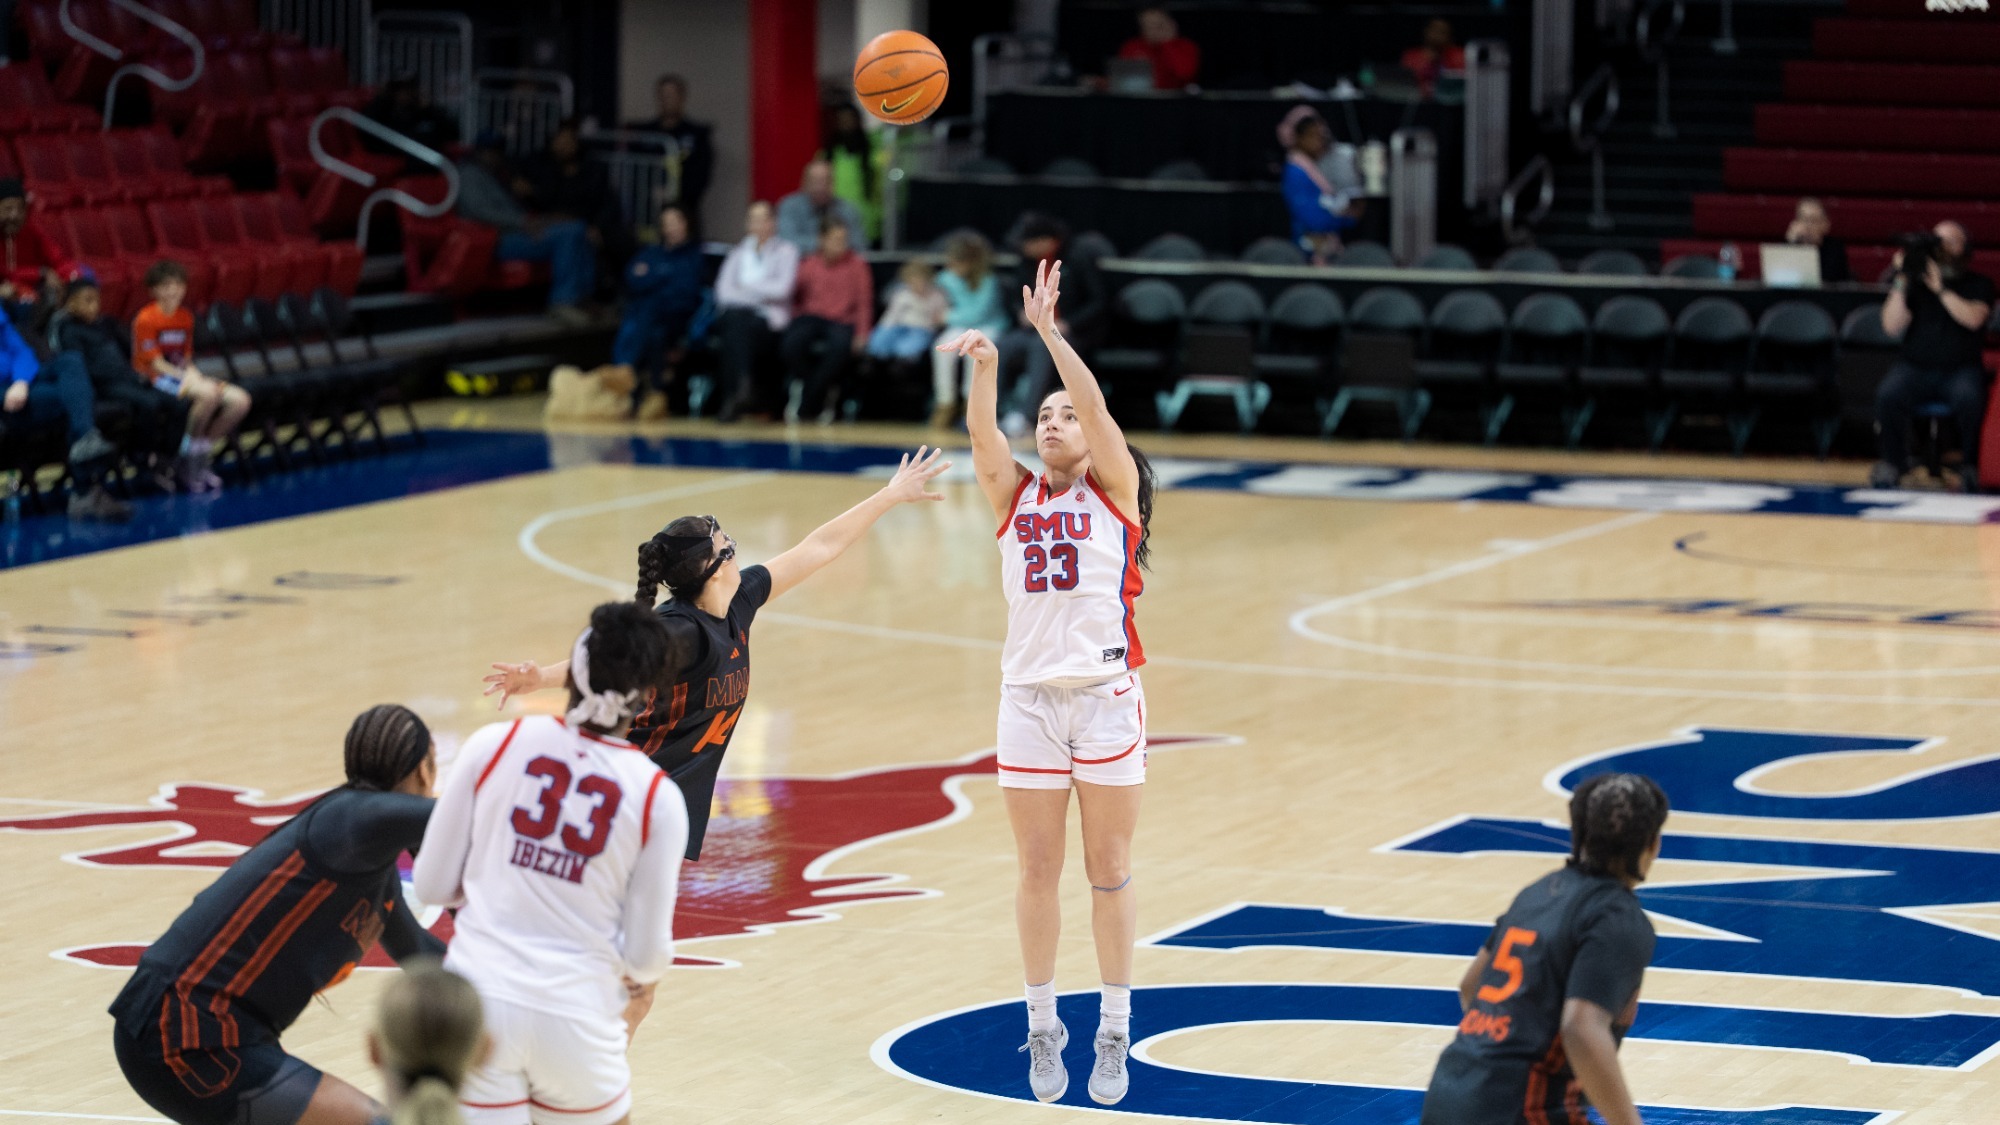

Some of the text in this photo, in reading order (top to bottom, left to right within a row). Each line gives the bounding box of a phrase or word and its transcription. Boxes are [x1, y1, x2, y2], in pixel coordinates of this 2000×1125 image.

[1014, 511, 1092, 543] SMU
[1024, 542, 1079, 593] 23
[510, 754, 623, 857] 33
[1477, 926, 1537, 1004] 5
